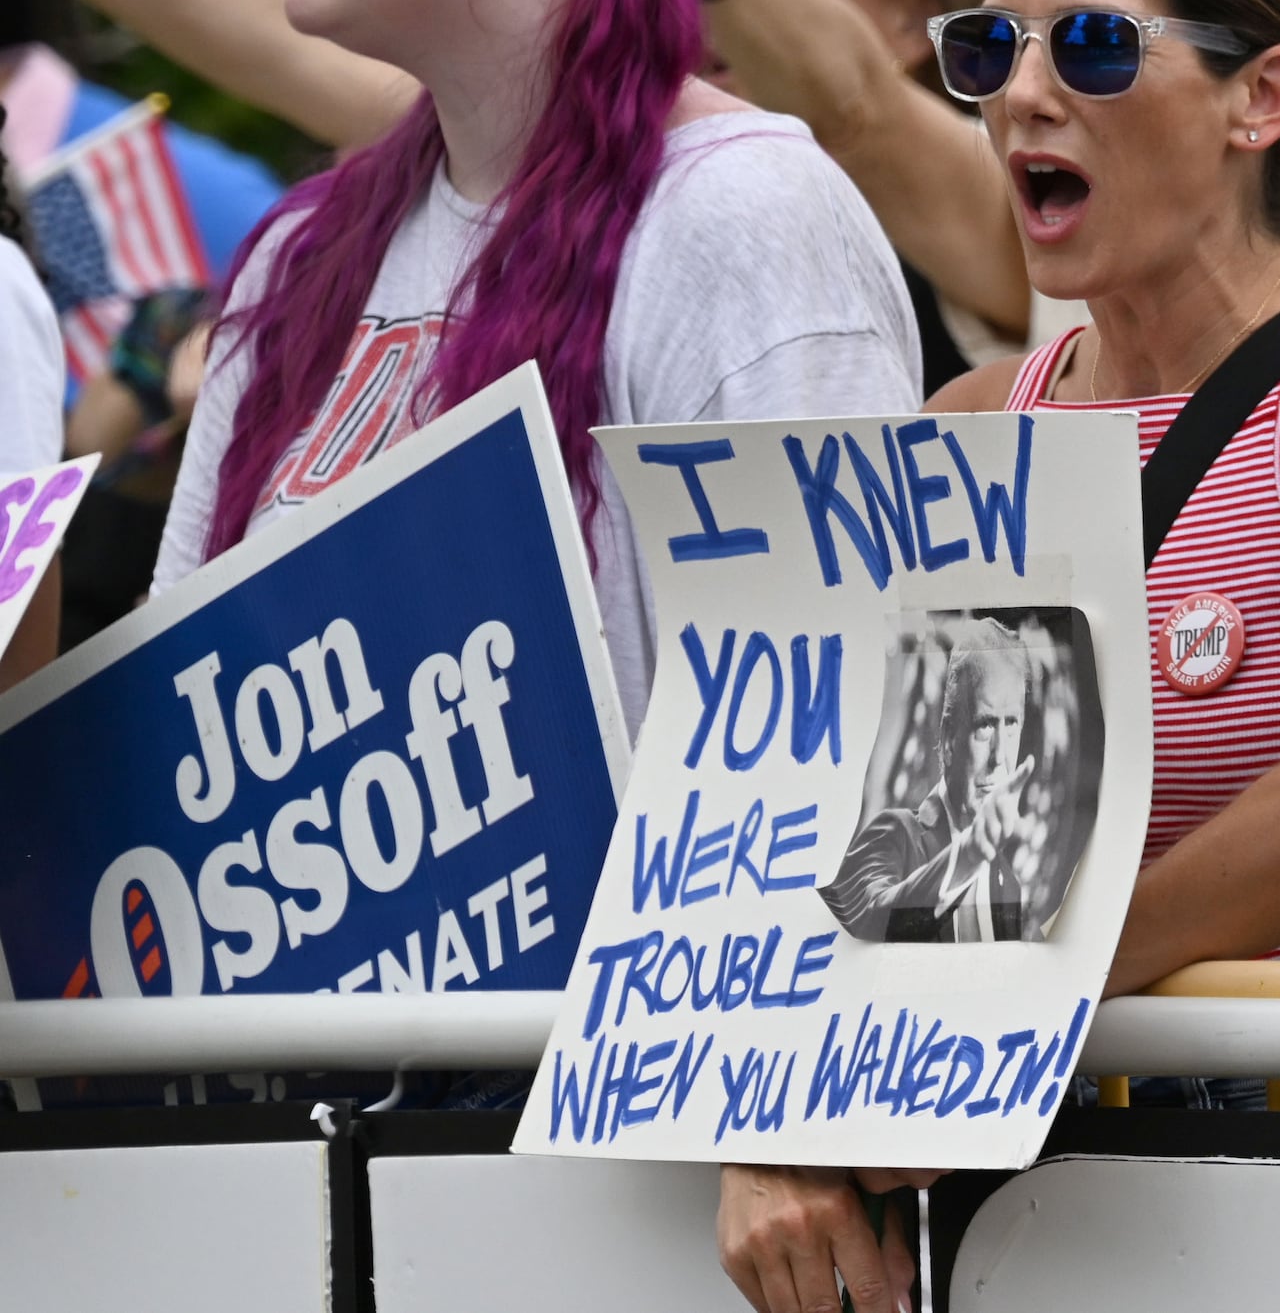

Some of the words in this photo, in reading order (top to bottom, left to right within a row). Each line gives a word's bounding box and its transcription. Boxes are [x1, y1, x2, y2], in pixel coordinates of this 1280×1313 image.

[637, 438, 770, 562] I
[781, 413, 1035, 592] KNEW
[1164, 604, 1191, 637] MAKE
[1194, 598, 1236, 632] AMERICA
[1166, 662, 1199, 687] SMART
[1203, 655, 1233, 685] AGAIN
[1174, 625, 1226, 661] TRUMP
[173, 617, 385, 824] Jon
[680, 623, 843, 772] YOU
[90, 619, 535, 999] Ossoff
[632, 790, 818, 914] WERE
[583, 926, 839, 1040] TROUBLE
[549, 1031, 714, 1145] WHEN
[715, 1047, 797, 1145] YOU
